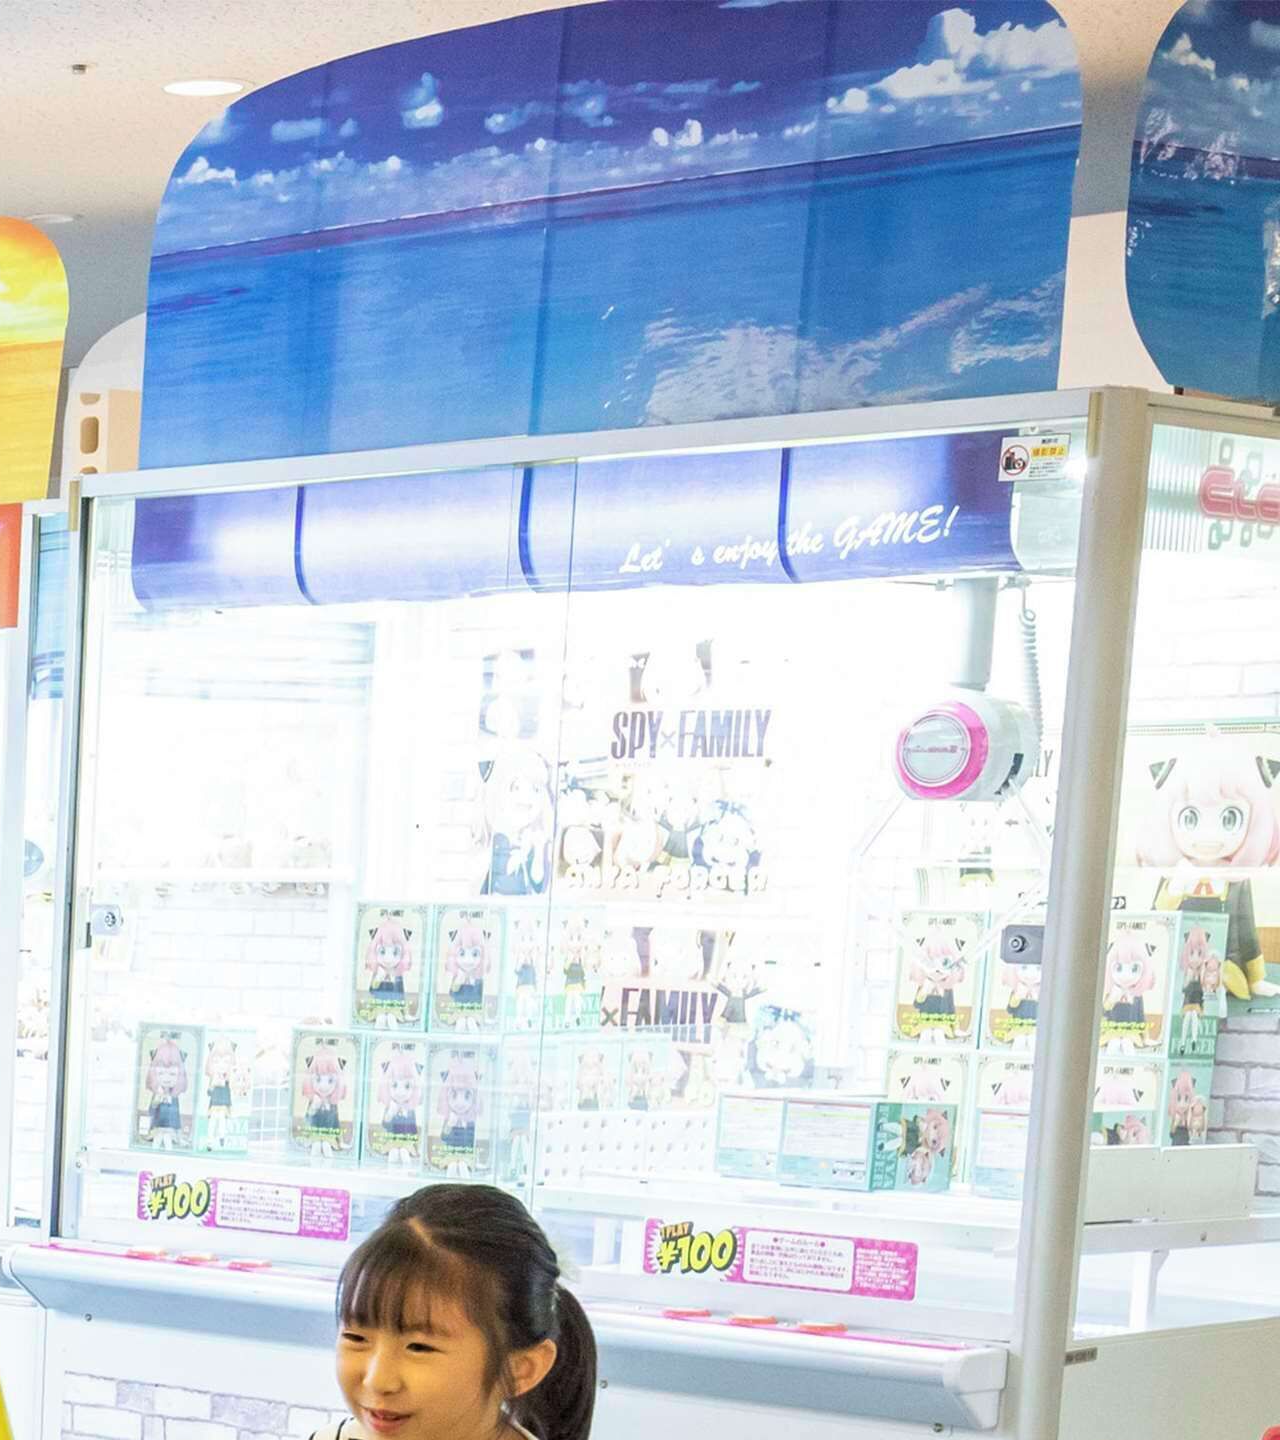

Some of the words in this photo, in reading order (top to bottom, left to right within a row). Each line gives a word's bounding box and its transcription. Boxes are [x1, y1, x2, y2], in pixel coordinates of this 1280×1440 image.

[713, 534, 781, 570] enjoy
[785, 522, 825, 556] the
[833, 504, 961, 560] GAME!
[147, 1179, 211, 1220] ¥100
[656, 1229, 737, 1274] ¥100
